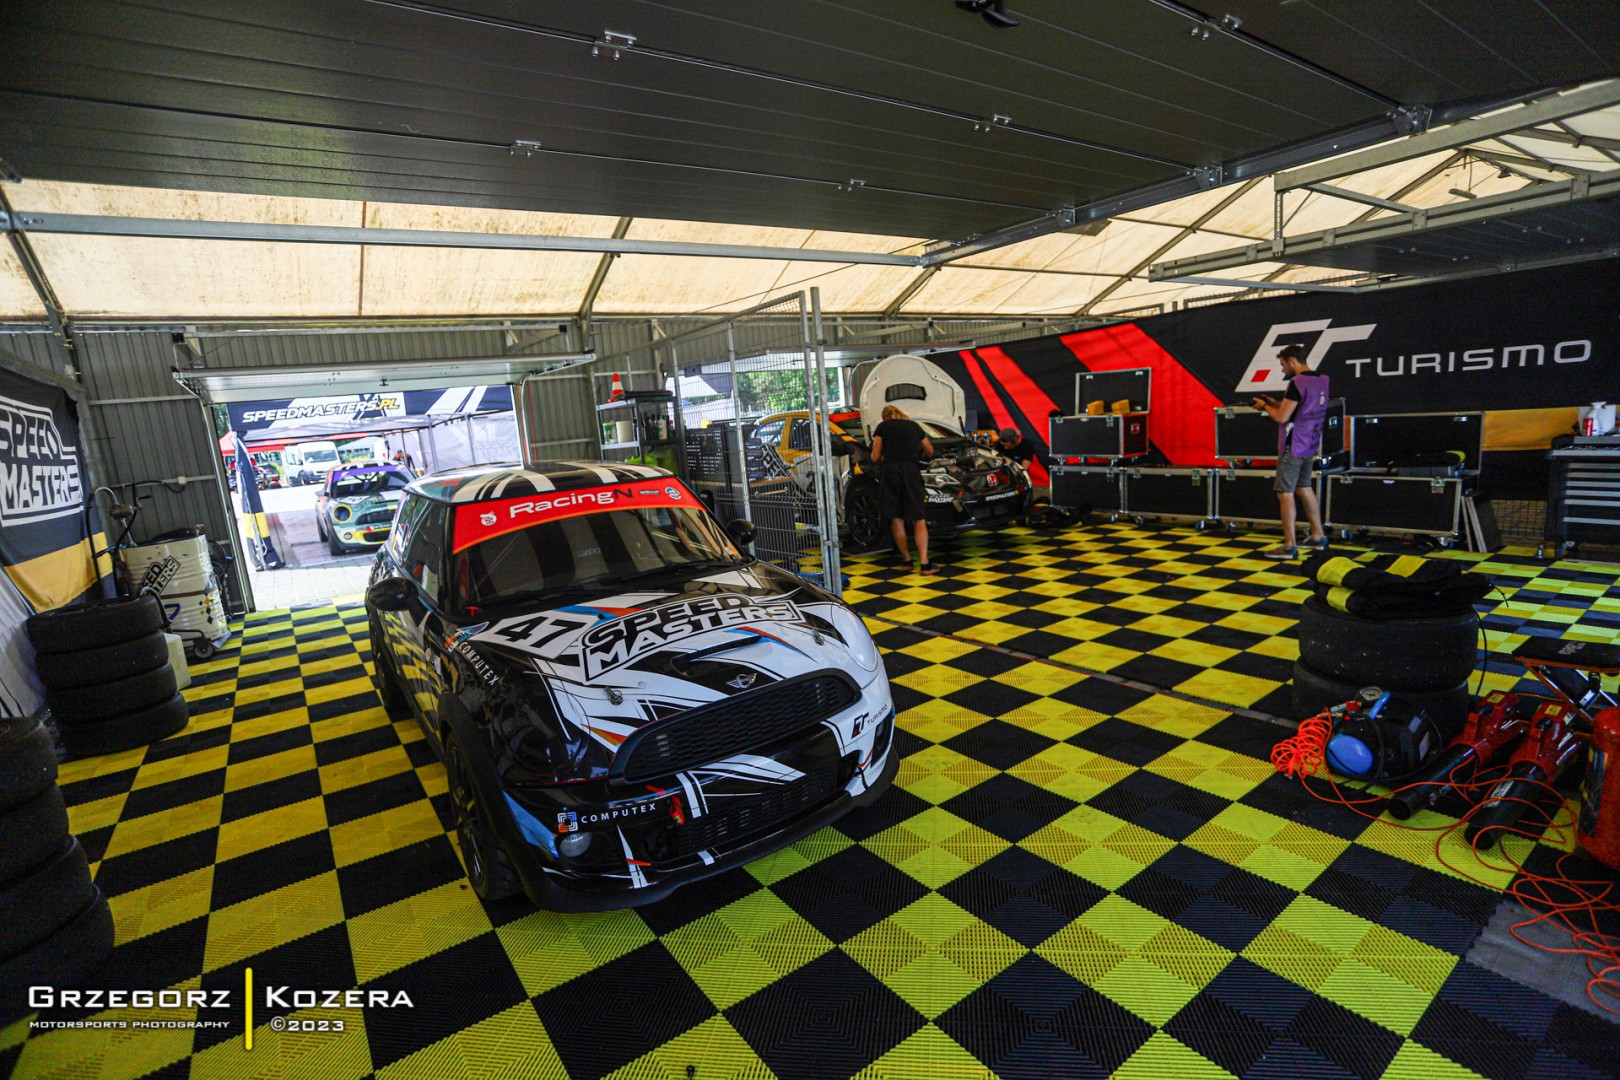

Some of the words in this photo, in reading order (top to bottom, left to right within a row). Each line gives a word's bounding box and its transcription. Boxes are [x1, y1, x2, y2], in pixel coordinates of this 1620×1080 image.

[1345, 339, 1592, 378] TURISMO
[242, 398, 400, 423] SPEEDMASTERS.PL
[0, 462, 80, 511] MASTERS
[494, 616, 587, 648] 47
[586, 604, 796, 679] MASTERS
[587, 595, 751, 648] SPEED
[458, 641, 499, 686] COMPUTEX
[581, 803, 656, 824] COMPUTEX
